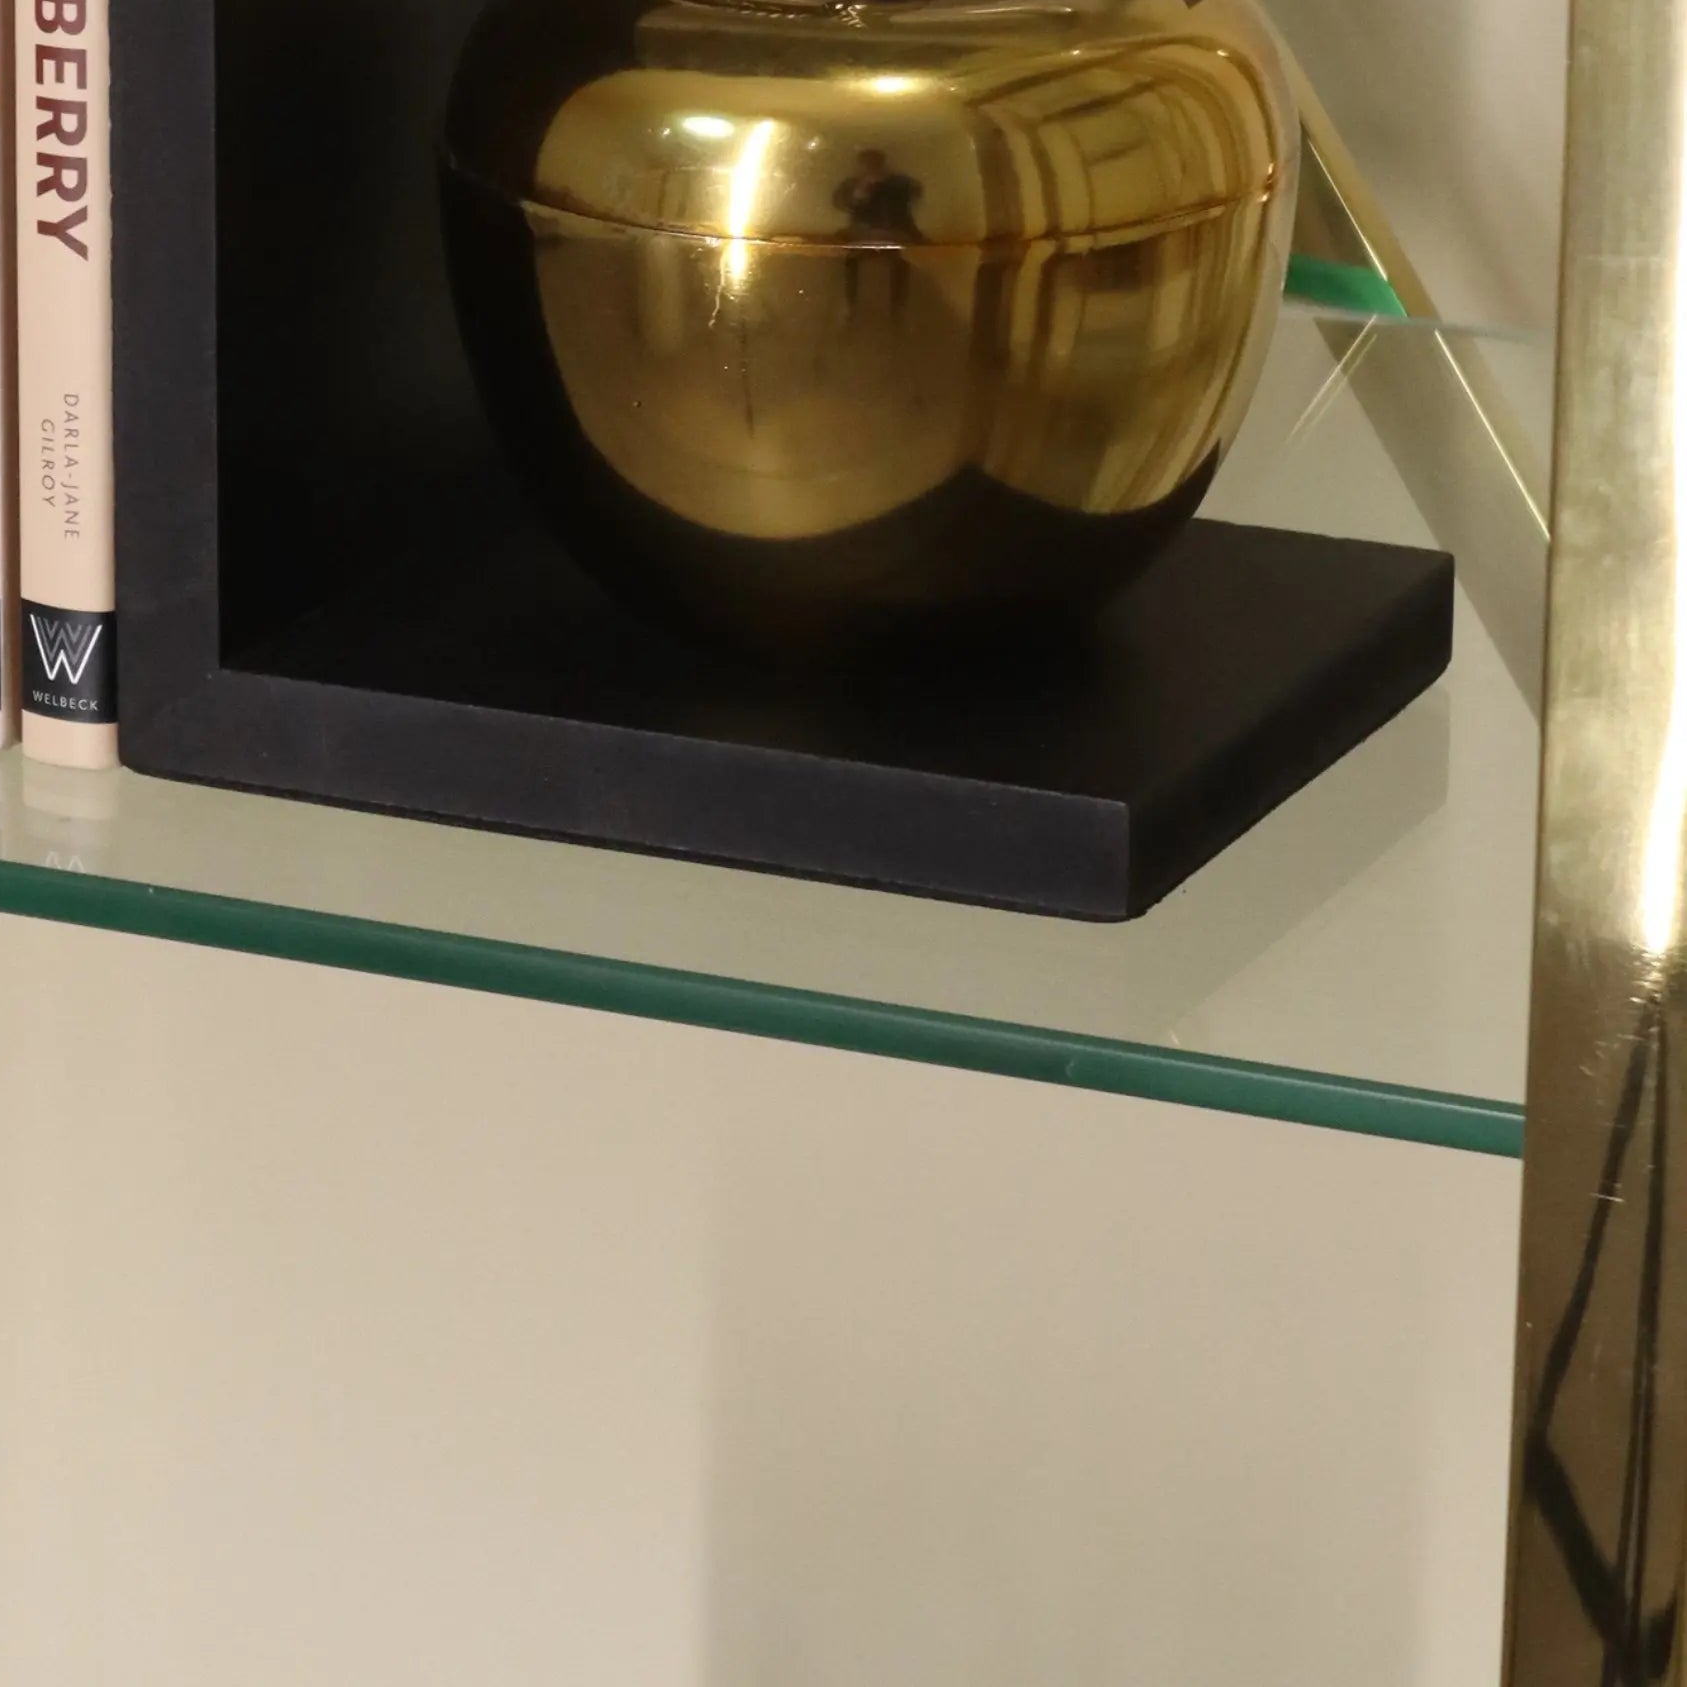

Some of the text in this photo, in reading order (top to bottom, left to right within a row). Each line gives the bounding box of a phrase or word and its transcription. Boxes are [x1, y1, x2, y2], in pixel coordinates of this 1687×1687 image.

[41, 418, 55, 508] GILROY
[61, 393, 79, 539] DARLA-JANE
[32, 689, 99, 711] WELBECK
